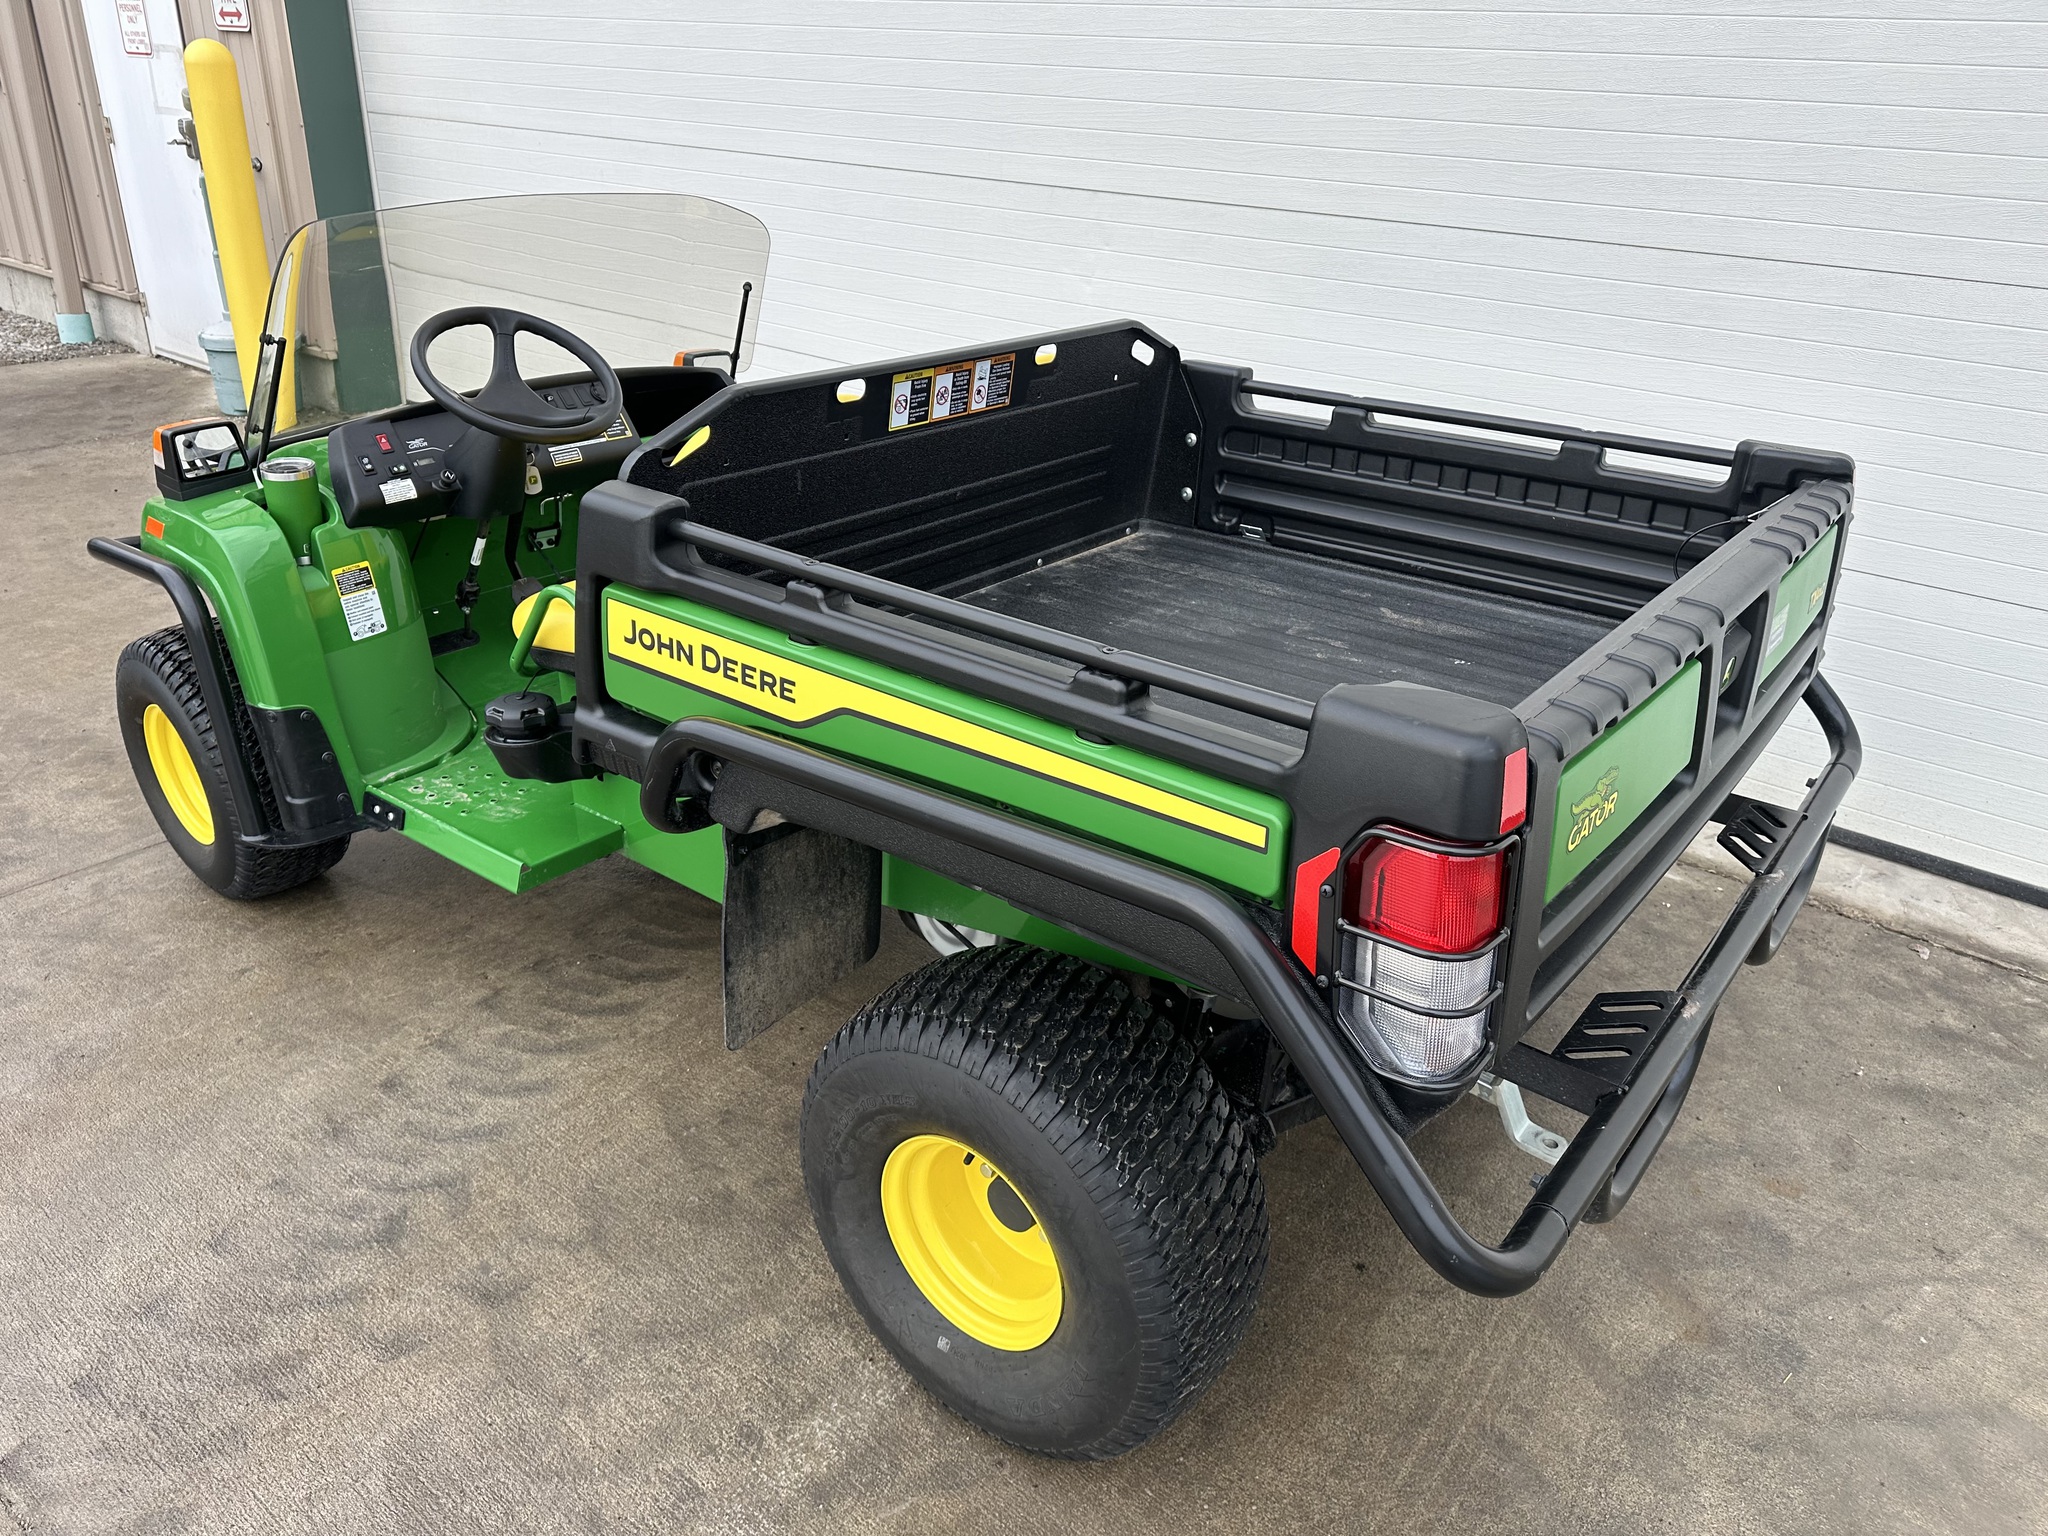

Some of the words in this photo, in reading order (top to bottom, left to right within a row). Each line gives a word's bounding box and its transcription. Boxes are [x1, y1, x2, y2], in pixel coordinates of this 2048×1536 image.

[118, 3, 143, 13] PERSONNEL
[126, 15, 138, 24] ONLY
[623, 619, 694, 667] JOHN
[701, 643, 797, 704] DEERE
[1566, 790, 1618, 853] GATOR
